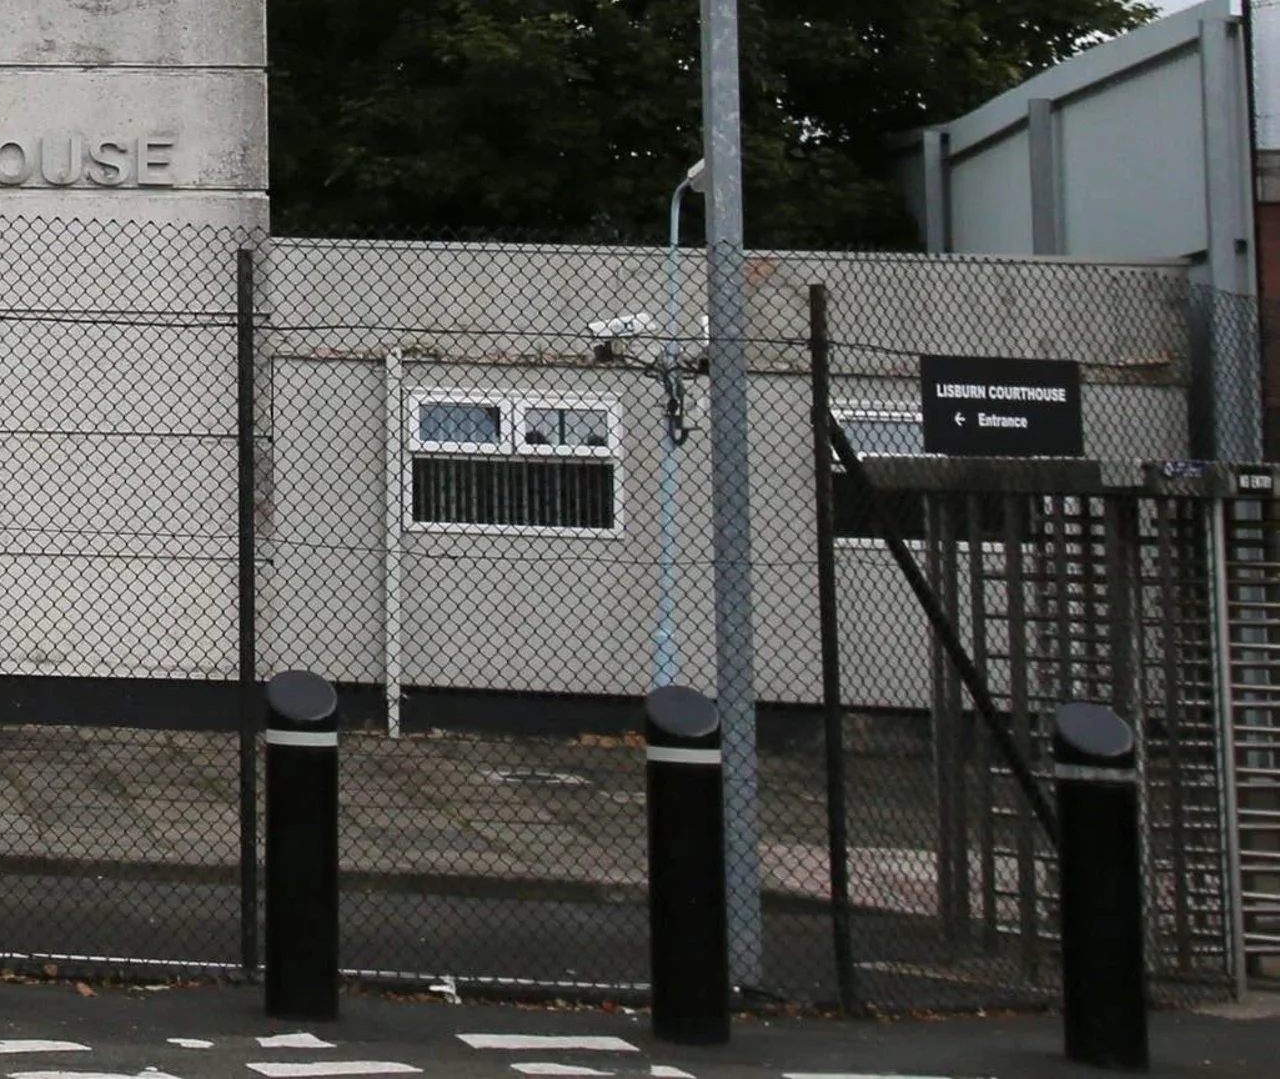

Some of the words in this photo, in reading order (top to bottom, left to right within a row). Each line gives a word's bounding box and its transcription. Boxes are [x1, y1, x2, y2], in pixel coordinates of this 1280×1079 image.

[936, 383, 987, 399] LISBURN
[989, 386, 1067, 402] COURTHOUSE
[978, 412, 1029, 428] Entrance
